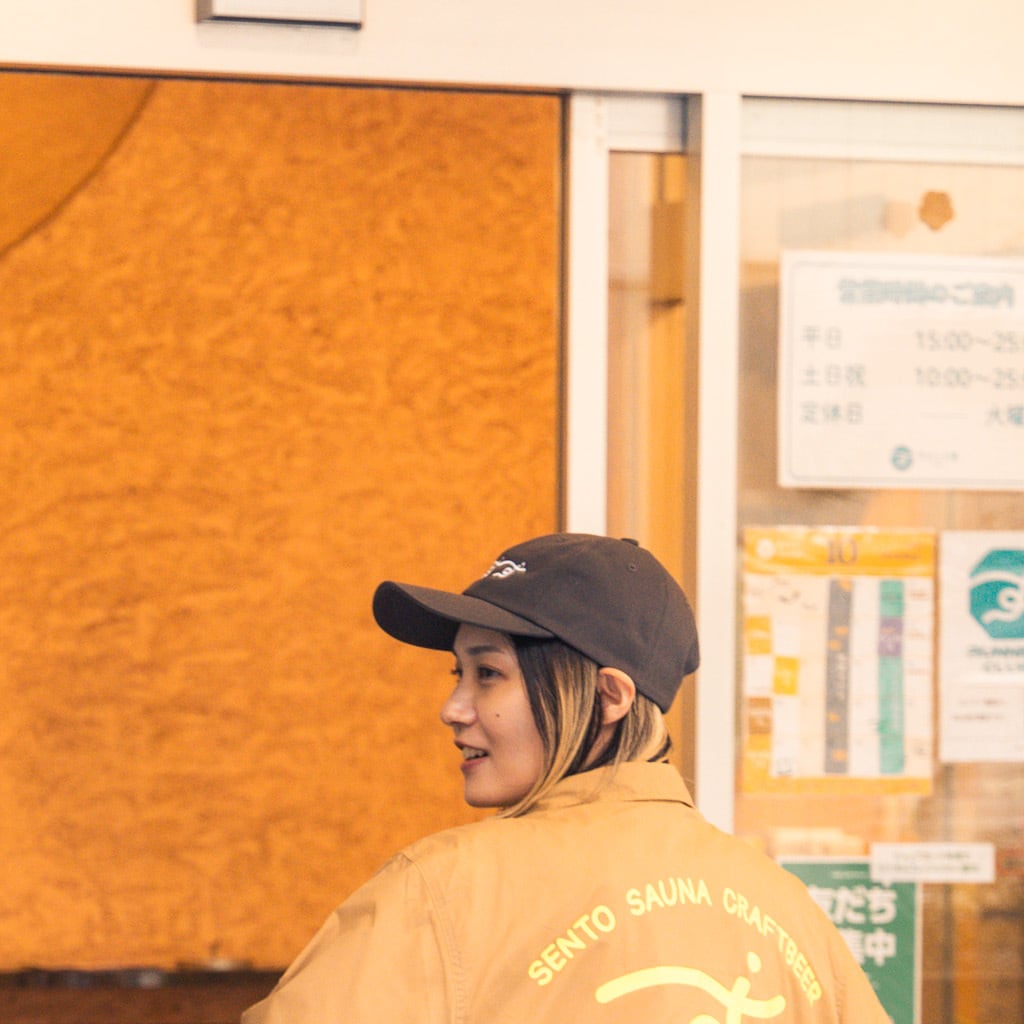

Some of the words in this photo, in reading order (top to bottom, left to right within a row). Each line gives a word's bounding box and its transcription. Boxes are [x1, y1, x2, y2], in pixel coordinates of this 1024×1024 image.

[800, 401, 864, 425] 定休日
[528, 905, 617, 987] SENTO
[626, 877, 713, 917] SAUNA
